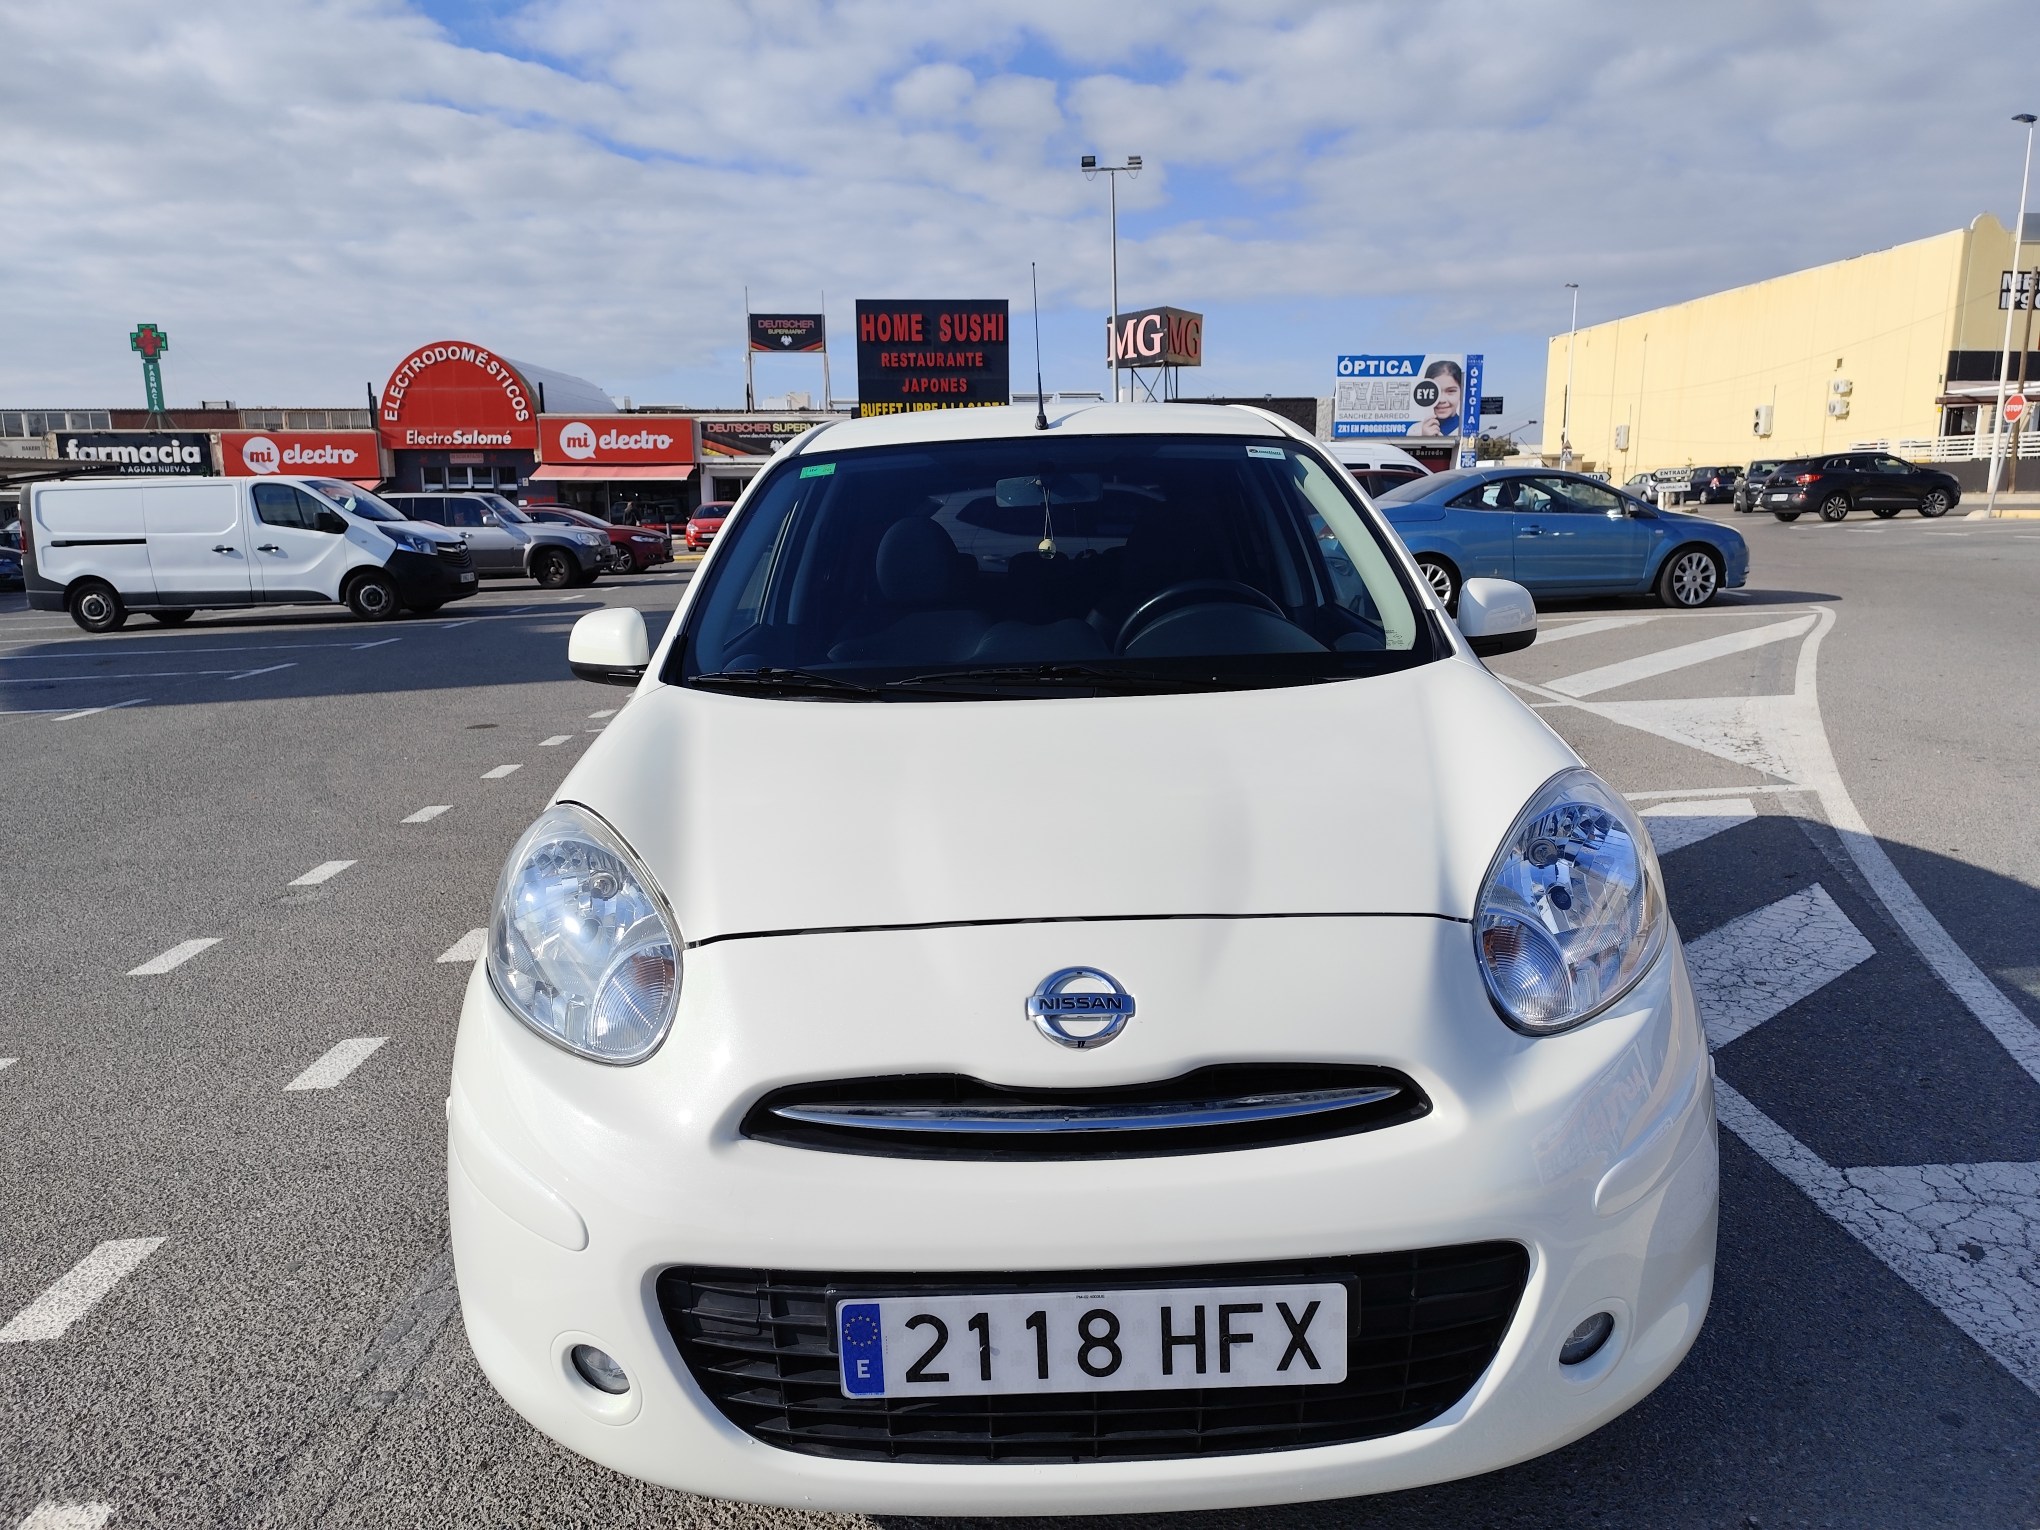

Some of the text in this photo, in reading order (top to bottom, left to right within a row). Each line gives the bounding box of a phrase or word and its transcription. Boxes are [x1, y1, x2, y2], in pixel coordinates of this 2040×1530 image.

[758, 320, 815, 328] DEUTSCHER
[861, 313, 1004, 342] HOME SUSHI
[1107, 314, 1164, 361] MG
[1167, 313, 1200, 359] MG
[881, 352, 983, 367] RESTAURANTE
[1338, 357, 1413, 375] ÓPTICA
[148, 364, 160, 411] FARMACIA
[384, 345, 529, 422] ELECTRODOMÉSTICOS
[902, 377, 968, 393] JAPONES
[1416, 388, 1435, 400] EYE
[860, 402, 903, 417] BUFFET
[2006, 404, 2023, 412] STOP
[707, 423, 771, 433] DEUTSCHER
[1337, 424, 1407, 433] 2X1 EN PROGRESIVOS
[566, 428, 674, 450] mi electro
[66, 438, 201, 464] farmacia
[249, 443, 359, 464] mi electro
[1039, 997, 1122, 1010] NISSAN
[856, 1300, 1322, 1383] E 2118 HFX
